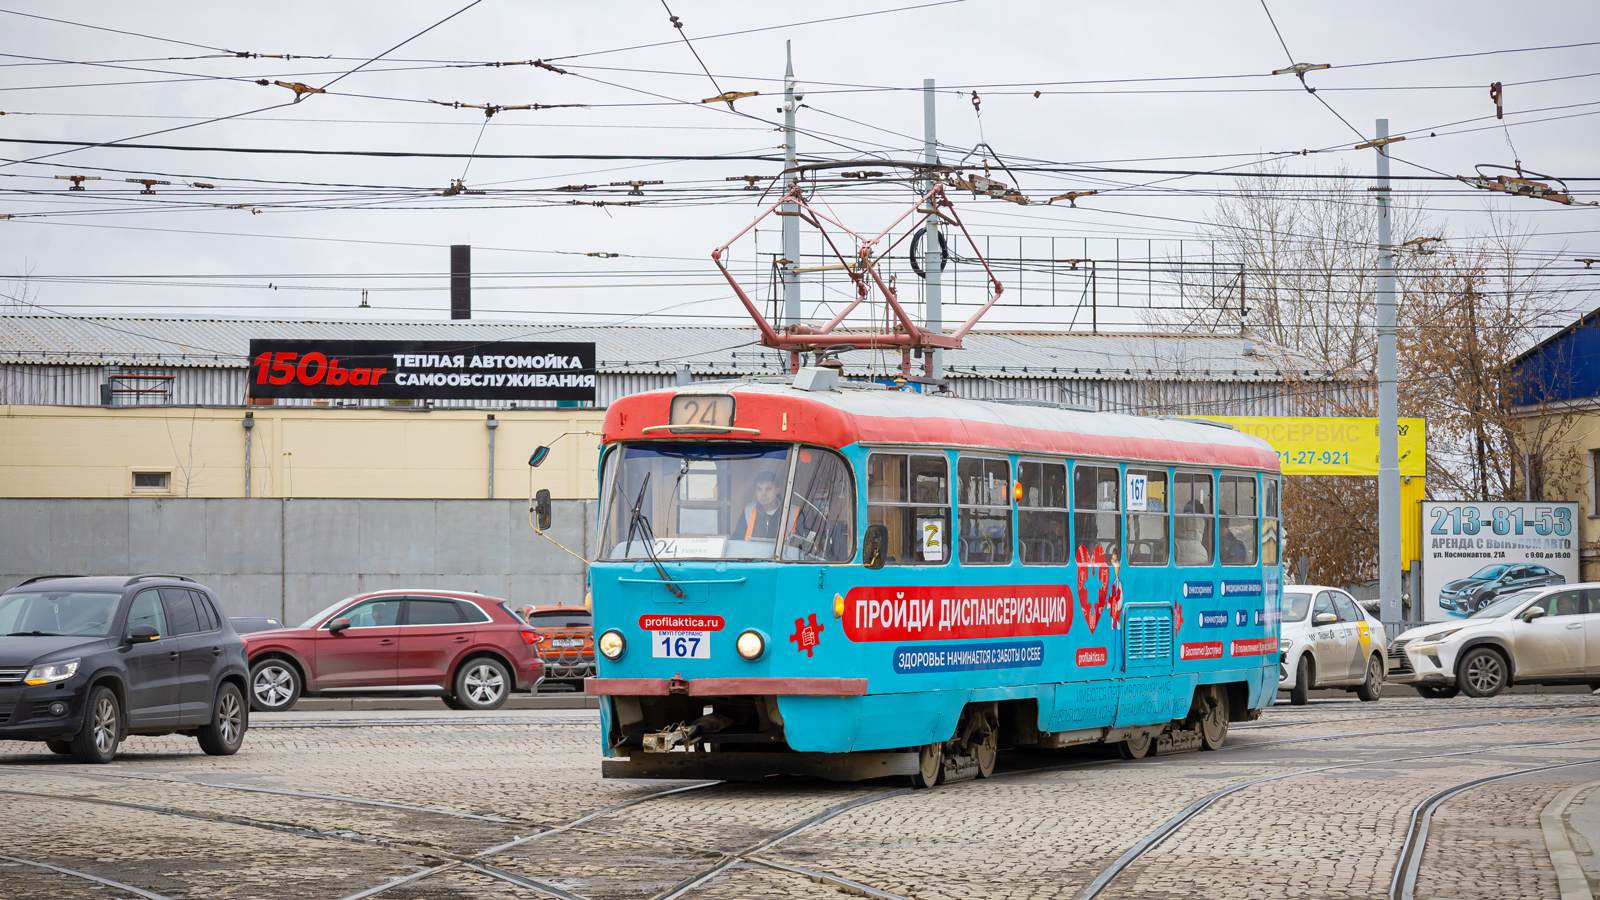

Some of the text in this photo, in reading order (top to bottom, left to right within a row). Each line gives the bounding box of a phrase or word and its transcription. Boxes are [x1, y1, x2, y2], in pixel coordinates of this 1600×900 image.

[254, 352, 387, 386] 150bar
[393, 353, 583, 369] ТЕПЛАЯ АВТОМОЙКА
[395, 373, 596, 388] САМООБСЛУЖИВАНИЯ
[684, 400, 717, 426] 24
[1130, 479, 1145, 500] 167
[1430, 506, 1572, 536] 213-81-53
[653, 539, 678, 558] 24
[1432, 537, 1571, 550] АРЕНДА С ВЫКУПОМ АВТО
[1493, 551, 1506, 559] 21А
[1530, 551, 1543, 559] 9:00
[1554, 551, 1571, 559] 18:00
[645, 617, 719, 628] profilaktica.ru
[856, 592, 1067, 632] ПРОЙДИ ДИСПАНСЕРИЗАЦИЮ
[661, 636, 701, 657] 167
[898, 646, 1041, 669] ЗДОРОВЬЕ НАЧИНАЕТСЯ С ЗАБОТЫ О СЕБЕ
